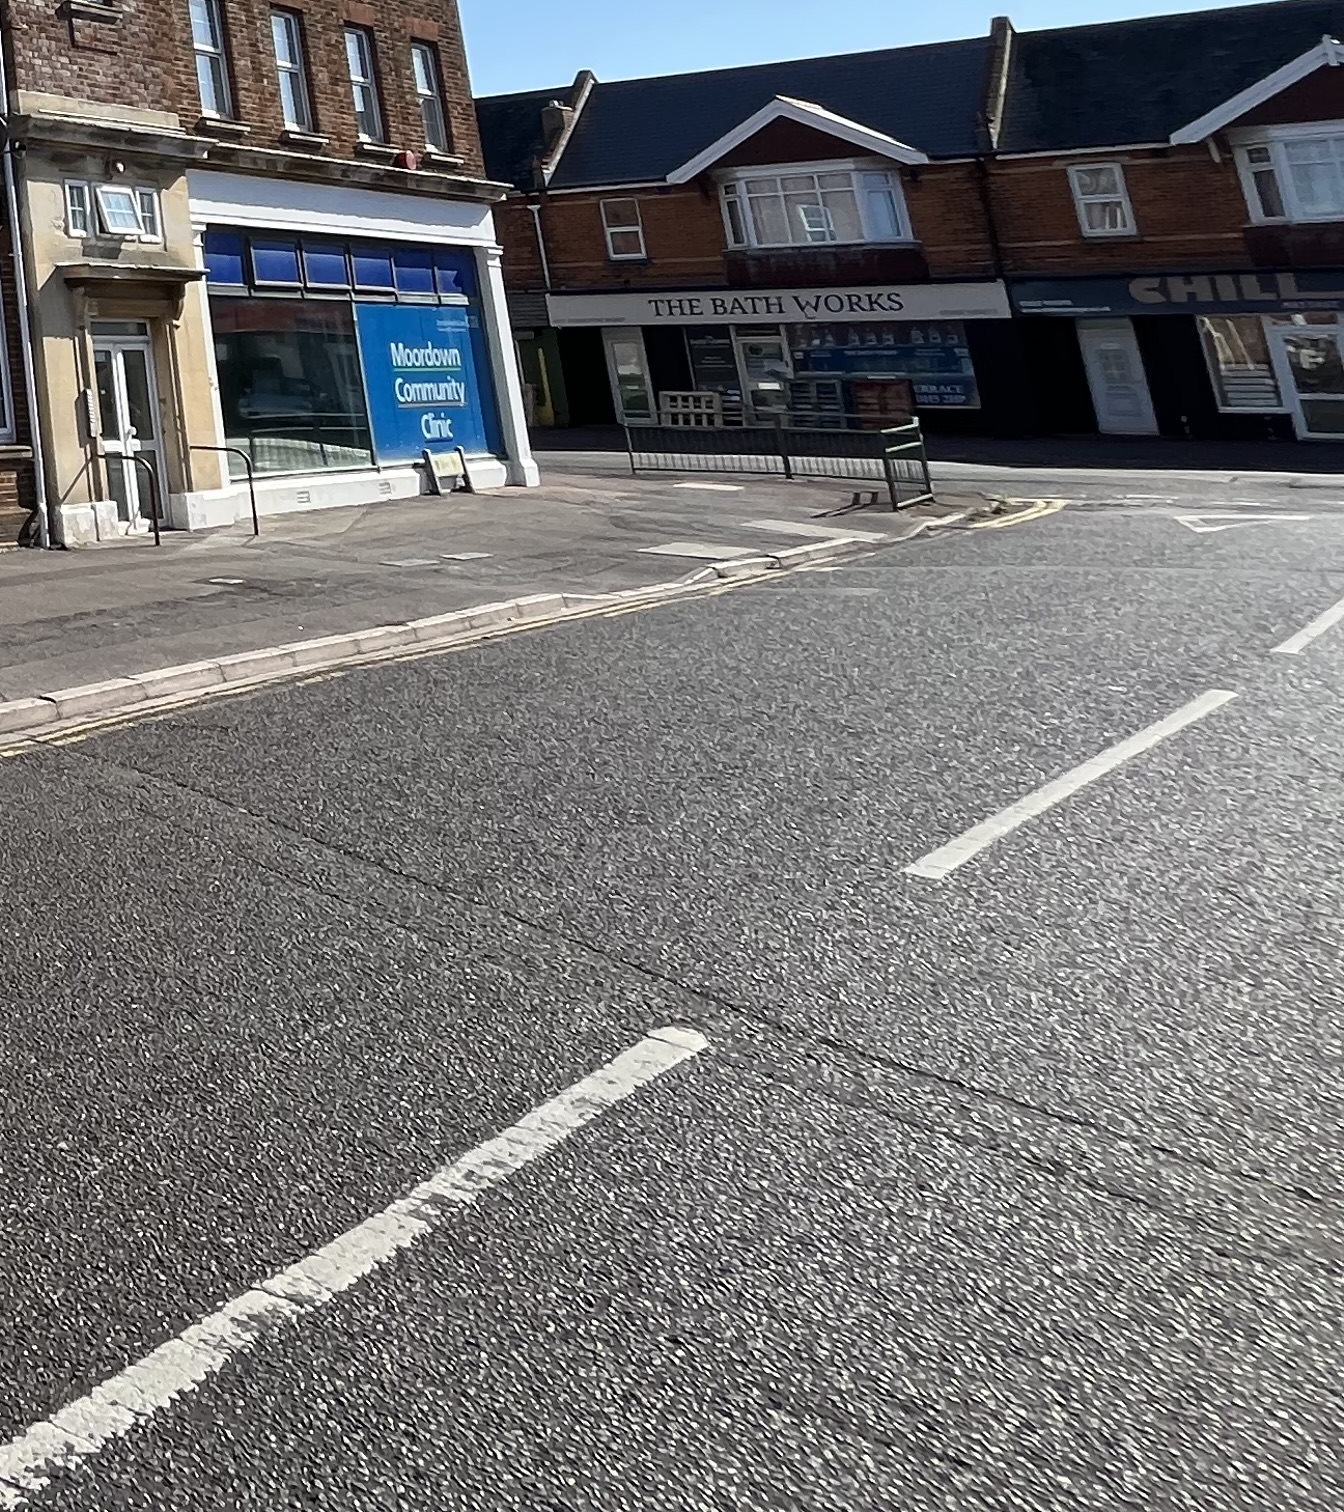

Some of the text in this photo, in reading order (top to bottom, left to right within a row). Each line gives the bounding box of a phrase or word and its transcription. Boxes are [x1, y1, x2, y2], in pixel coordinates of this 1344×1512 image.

[648, 292, 904, 320] THE BATH WORKS
[390, 341, 462, 367] Moordown
[395, 375, 465, 406] Community
[420, 412, 453, 439] Clinic
